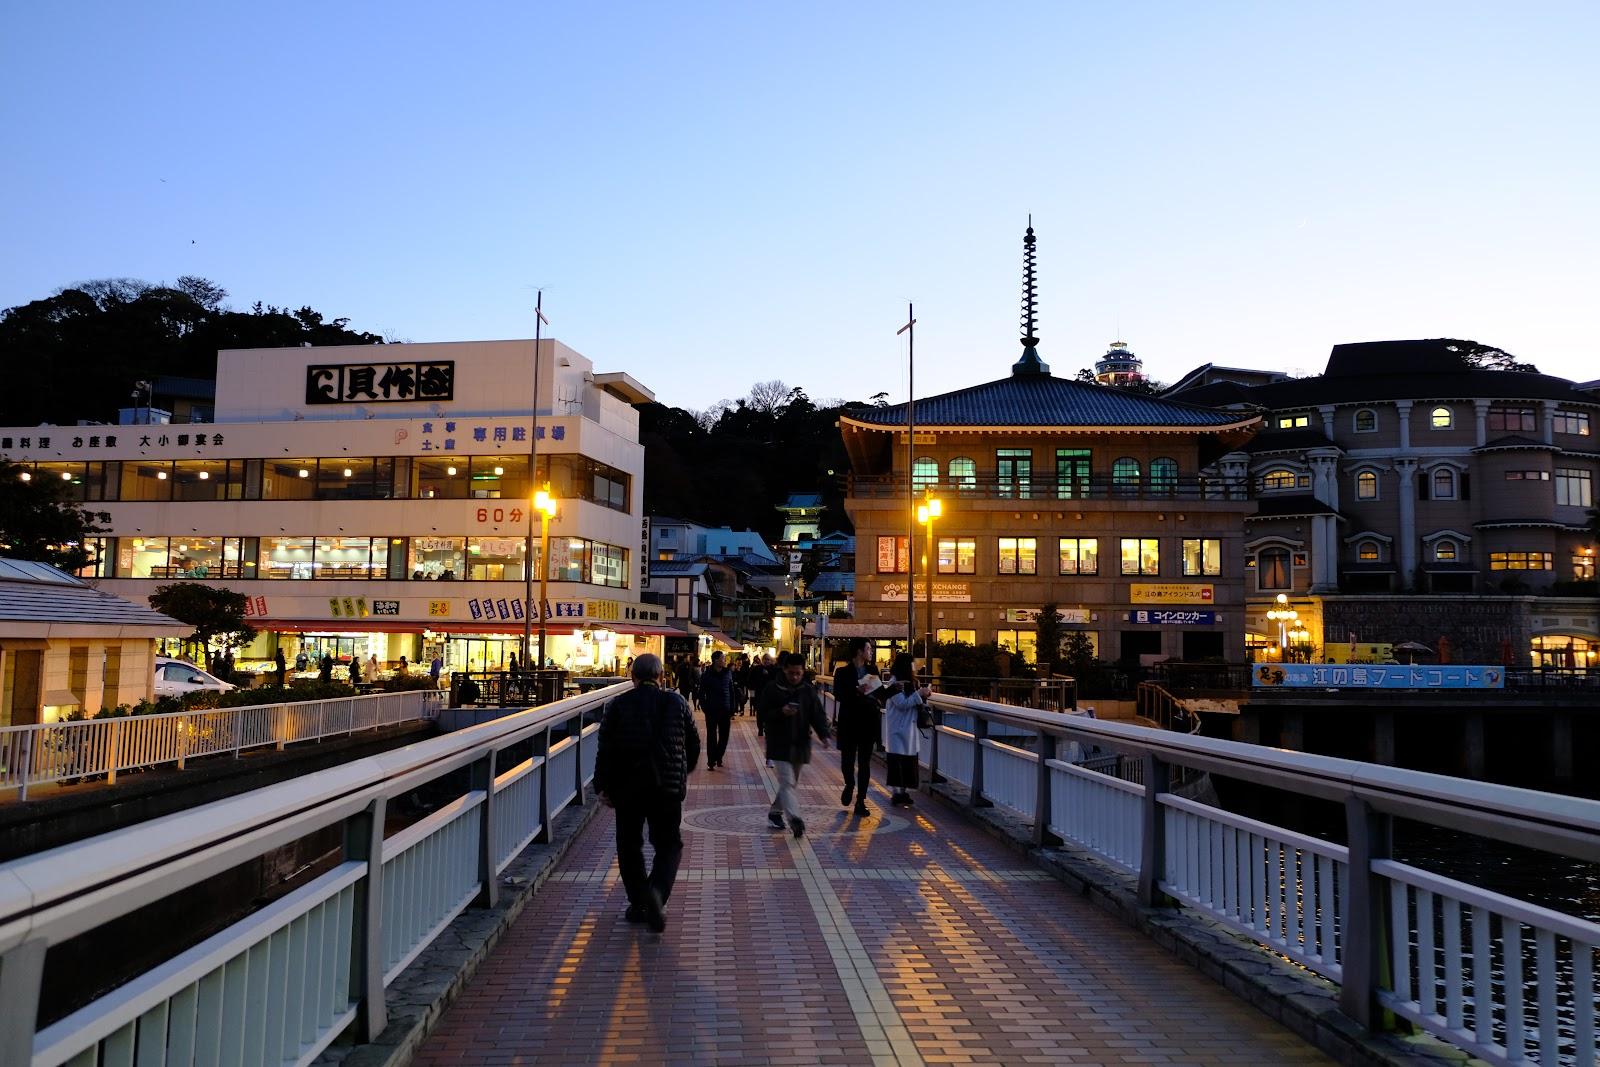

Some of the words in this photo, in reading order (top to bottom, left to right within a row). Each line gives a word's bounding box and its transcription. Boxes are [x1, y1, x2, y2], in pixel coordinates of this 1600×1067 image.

[72, 436, 117, 448] お座敷
[139, 433, 224, 447] 大小御宴会
[394, 428, 409, 445] P
[473, 425, 565, 442] 専用駐車場
[901, 583, 925, 591] MNEY
[932, 583, 967, 591] XCHANGE
[1154, 611, 1208, 620] コインロッカー
[1312, 667, 1479, 685] 江の島フードコート
